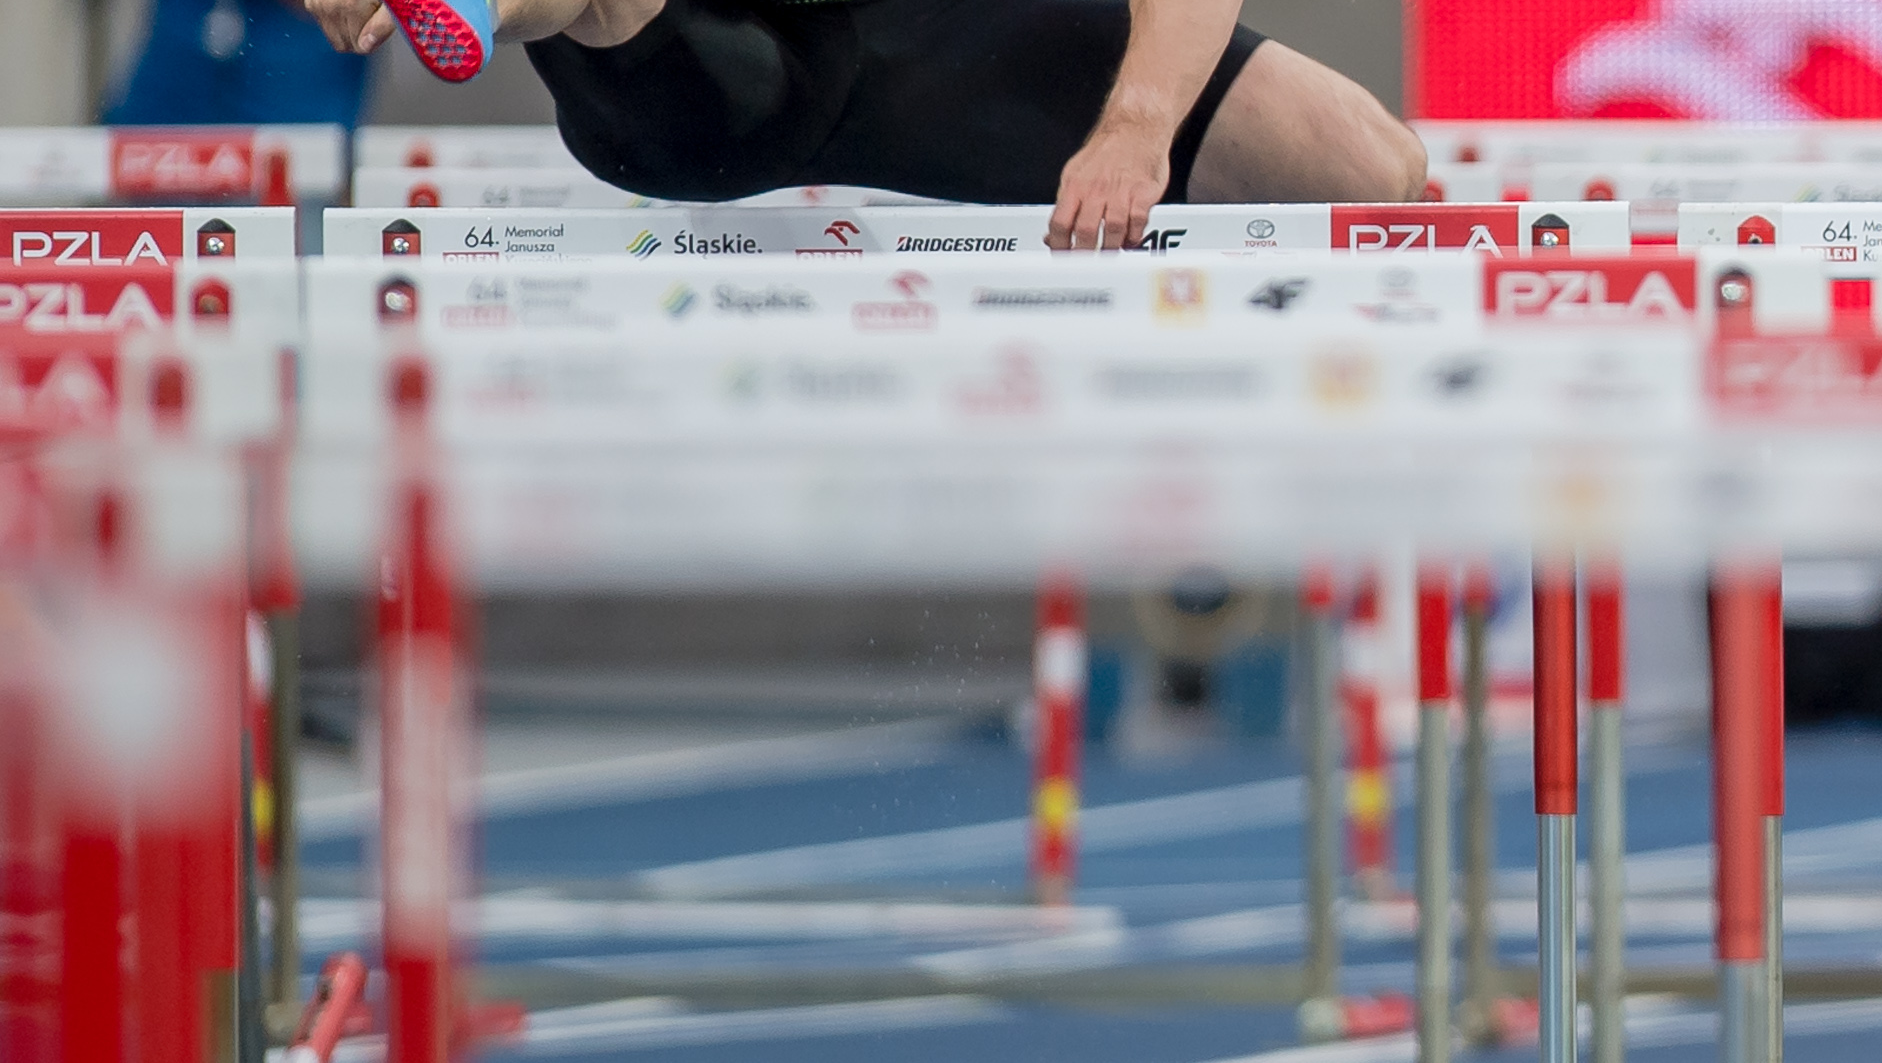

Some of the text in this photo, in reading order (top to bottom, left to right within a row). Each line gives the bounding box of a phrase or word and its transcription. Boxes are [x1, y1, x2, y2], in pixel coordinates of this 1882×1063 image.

[464, 224, 564, 249] 64. Memoriał
[1349, 225, 1503, 258] PZLA
[1822, 220, 1858, 242] 64.
[12, 231, 167, 266] PZLA
[505, 241, 555, 253] Janusza
[896, 236, 1019, 253] BRIDGESTONE
[1244, 240, 1278, 248] TOYOTA
[1495, 270, 1688, 322] PZLA
